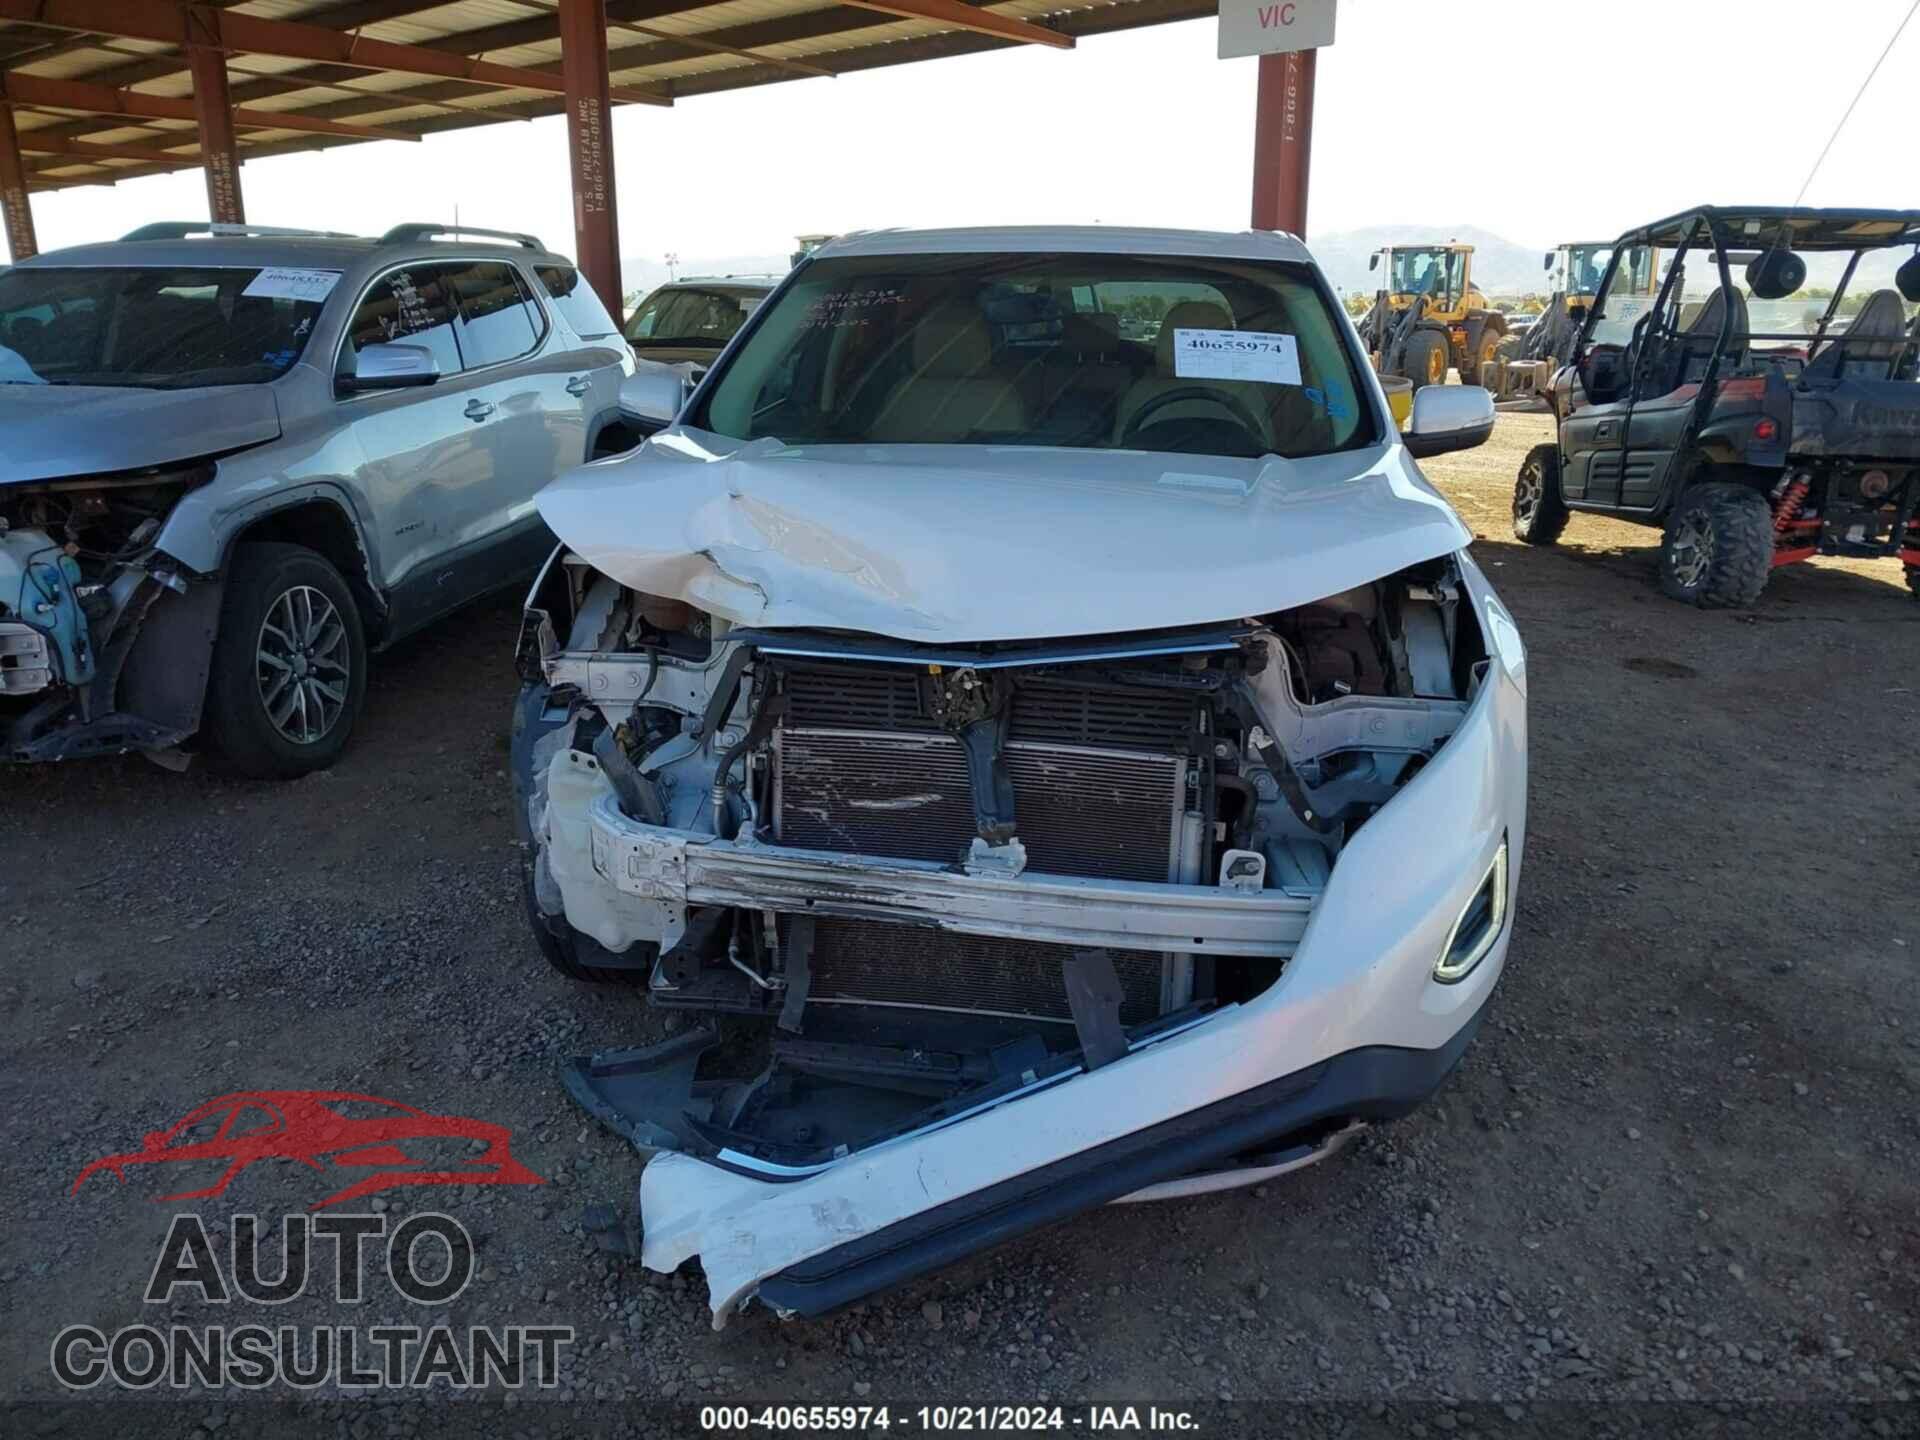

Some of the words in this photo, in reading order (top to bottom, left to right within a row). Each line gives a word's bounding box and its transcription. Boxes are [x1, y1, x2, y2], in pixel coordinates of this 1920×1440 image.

[1258, 3, 1296, 29] VIC
[578, 97, 589, 122] INC.
[581, 129, 592, 181] PREFAB
[1187, 339, 1282, 354] 40655974
